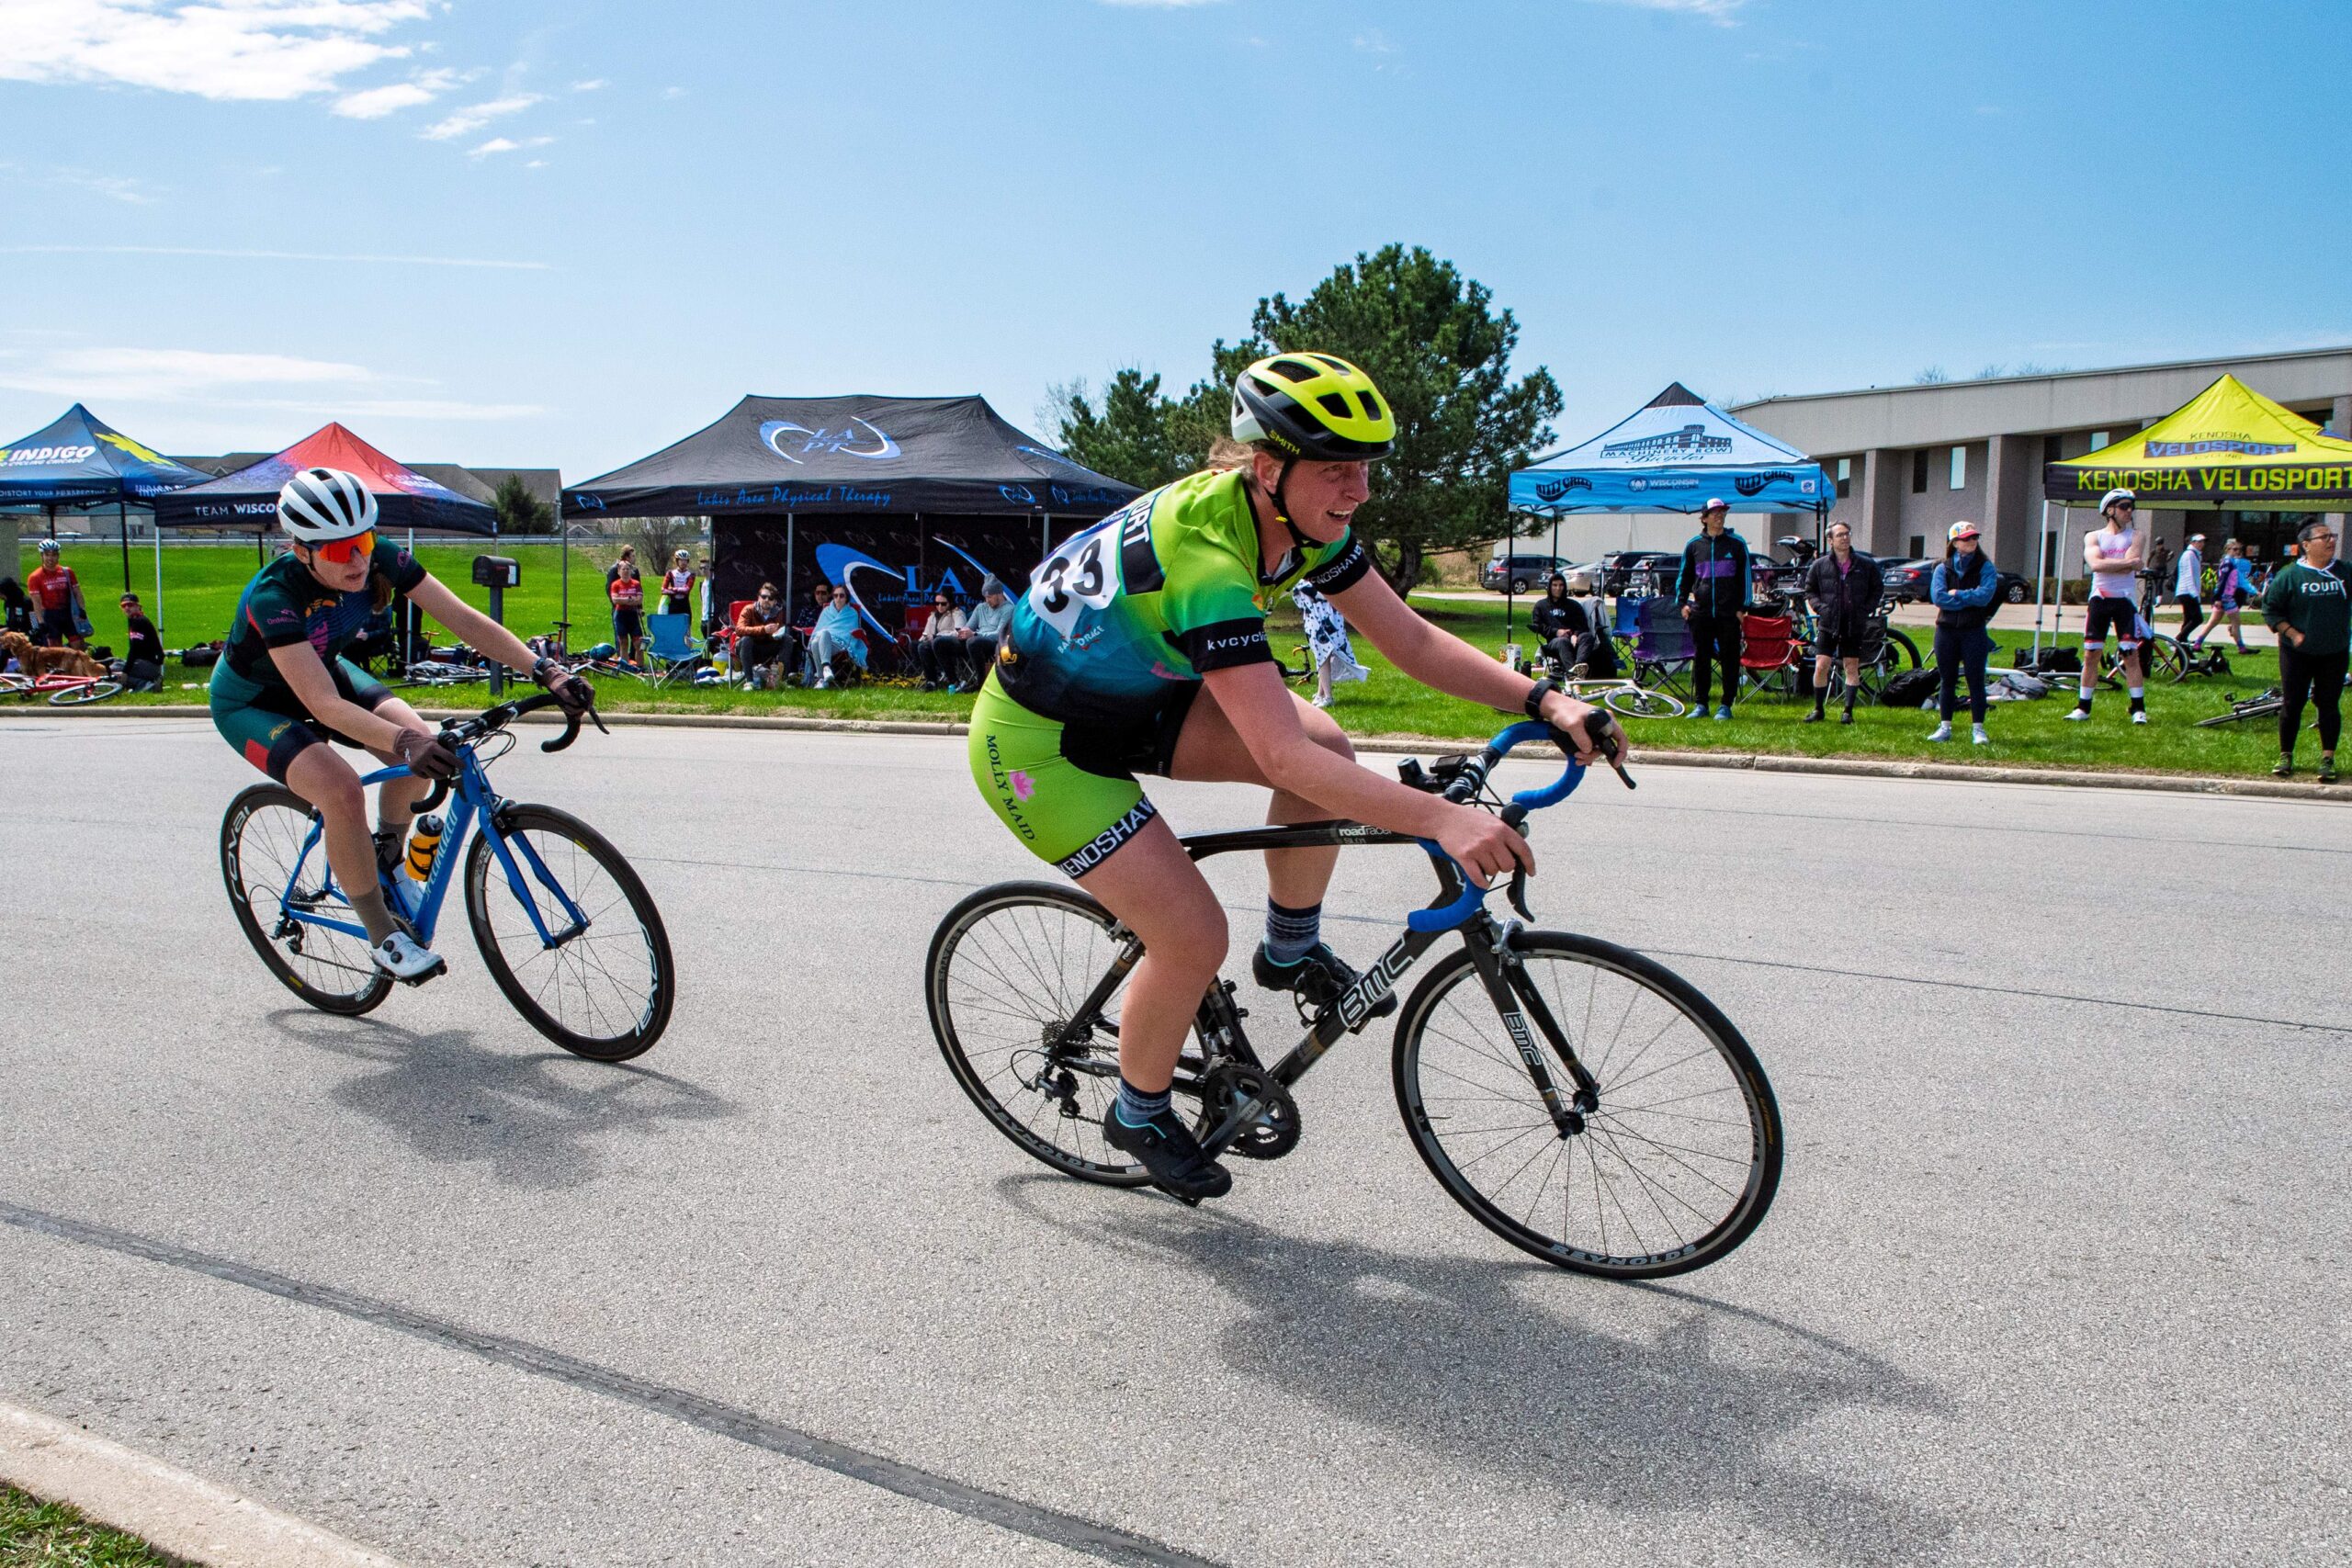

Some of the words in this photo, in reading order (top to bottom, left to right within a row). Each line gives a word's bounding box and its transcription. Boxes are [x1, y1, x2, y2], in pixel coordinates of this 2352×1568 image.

[1269, 430, 1301, 455] SMITH
[2190, 431, 2252, 440] KENOSHA
[8, 446, 96, 462] INDIGO
[1604, 447, 1688, 457] MACHINERY
[1695, 446, 1729, 455] ROW
[2147, 440, 2295, 457] VELOSPORT
[2077, 468, 2193, 491] KENOSHA
[2197, 467, 2352, 491] VELOSPORT
[697, 492, 730, 506] Lakes
[737, 488, 765, 505] Area
[773, 486, 831, 507] Physical
[840, 486, 890, 506] Therapy
[195, 506, 229, 516] TEAM
[233, 502, 279, 515] WISCO
[902, 566, 967, 593] LA
[1041, 538, 1103, 614] 33
[987, 735, 1009, 791] MOLLY
[1002, 796, 1035, 840] MAID
[1338, 934, 1416, 1028] BMC
[1503, 1011, 1543, 1066] BMC
[985, 1098, 1097, 1170] REYNOLDS
[1549, 1243, 1698, 1266] REYNOLDS
